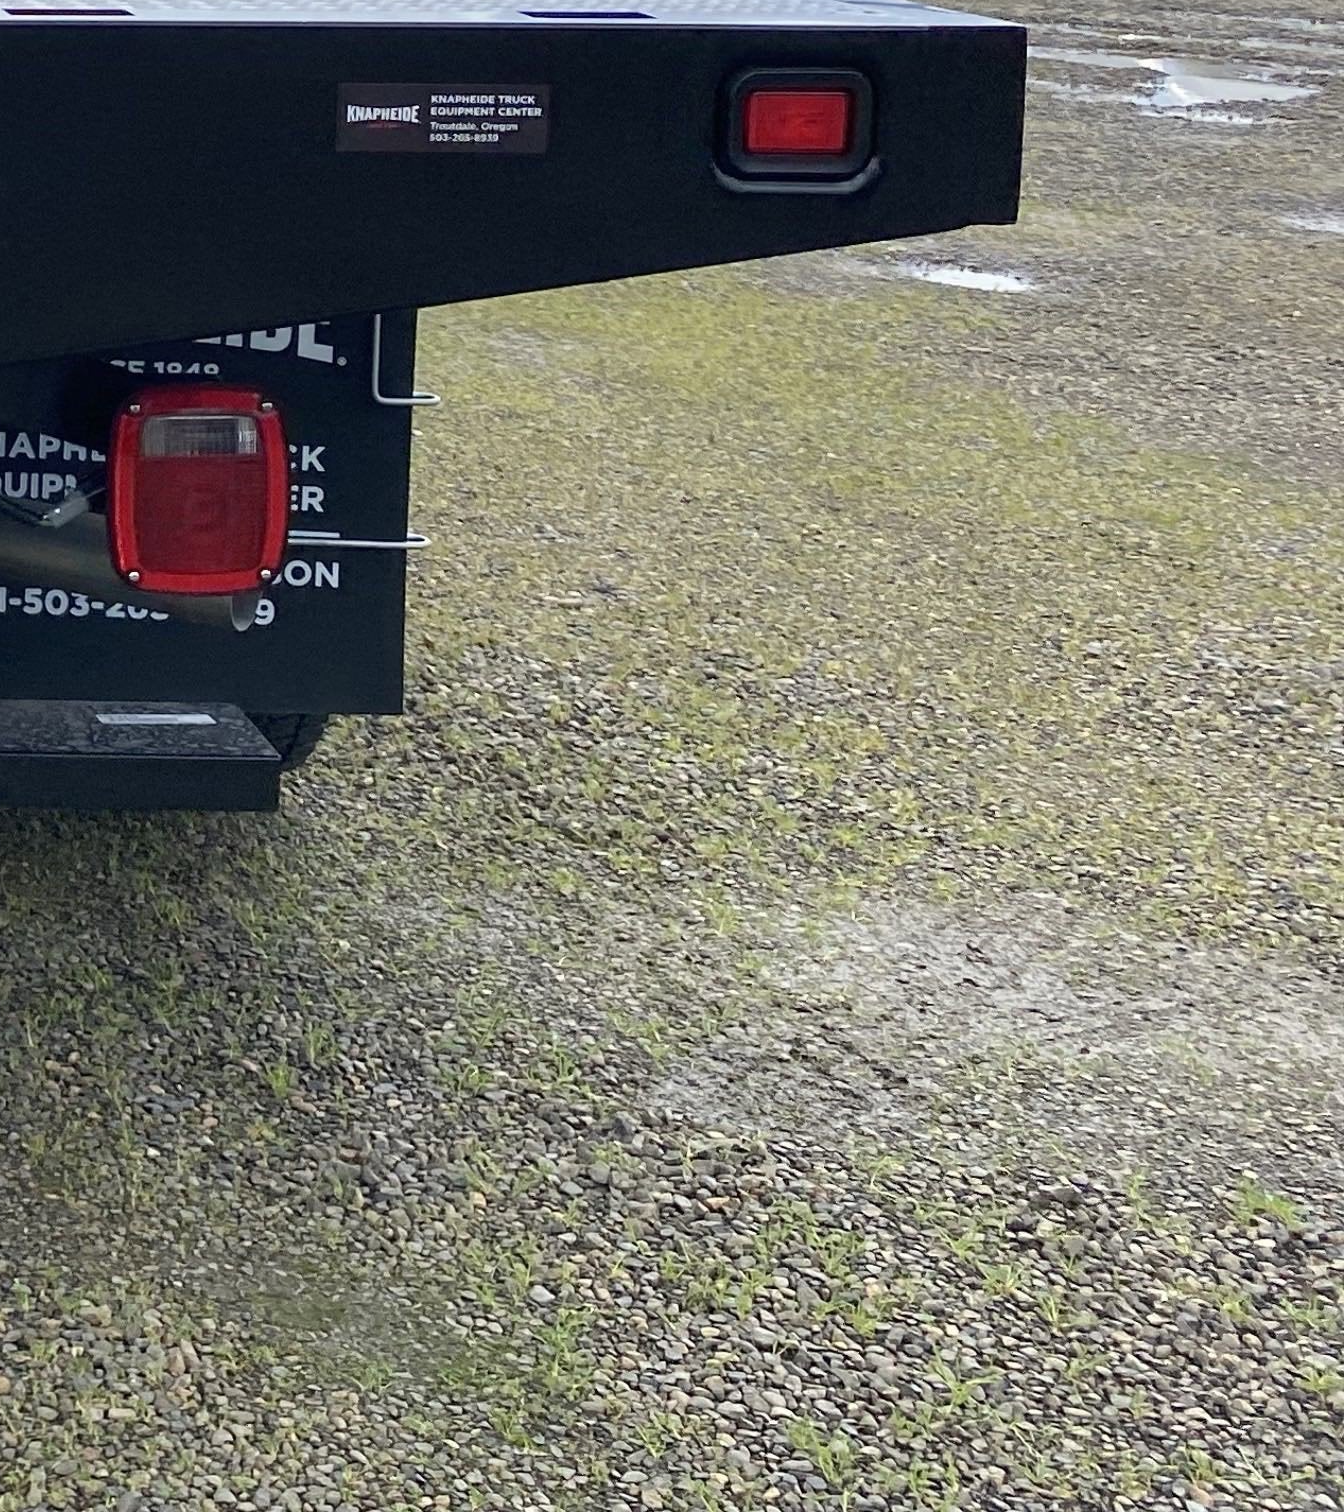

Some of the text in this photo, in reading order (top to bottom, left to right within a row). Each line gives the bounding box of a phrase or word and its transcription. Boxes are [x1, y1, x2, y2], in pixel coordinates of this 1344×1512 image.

[430, 94, 536, 106] KNAPHEIDE TRUCK
[346, 104, 421, 124] KNAPHEIDE
[430, 107, 542, 118] EQUIPMENT CENTER
[481, 122, 518, 133] Oregon
